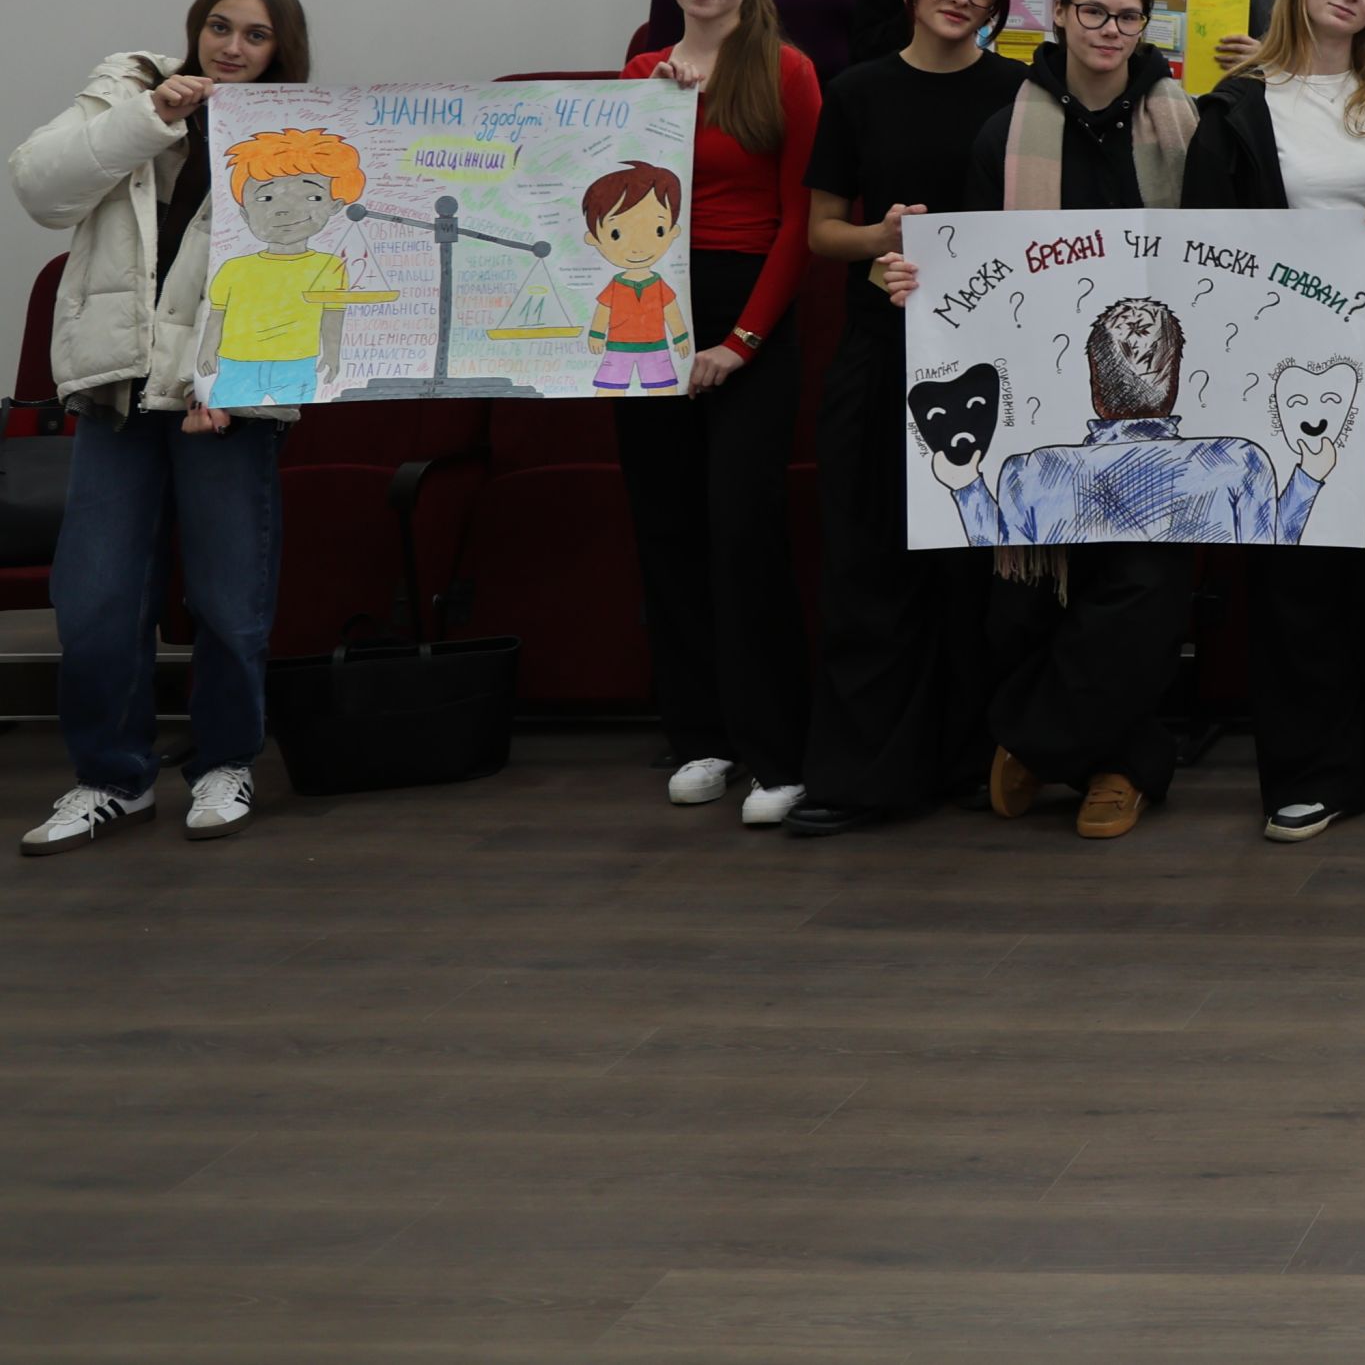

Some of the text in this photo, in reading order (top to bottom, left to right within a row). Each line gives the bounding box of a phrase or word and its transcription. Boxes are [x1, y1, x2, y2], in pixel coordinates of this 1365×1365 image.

[364, 95, 464, 126] ЗНАННЯ
[474, 102, 544, 142] здобуті
[554, 98, 631, 129] ЧЕСНО
[369, 223, 415, 240] ОБМАН
[373, 240, 433, 254] НЕЧЕСНІСТЬ
[1024, 229, 1106, 274] БРЕХНІ
[1123, 229, 1163, 259] ЧИ
[1183, 240, 1260, 278] МАСКА
[386, 268, 434, 282] ФАЛЬШ
[346, 303, 437, 317] АМОРАЛЬНІСТЬ
[457, 309, 494, 326] ЧЕСТЬ
[342, 333, 438, 347] ЛИЦЕМІРСТВО
[346, 362, 414, 378] ПЛАГІАТ
[914, 359, 960, 382] ПЛАГІАТ
